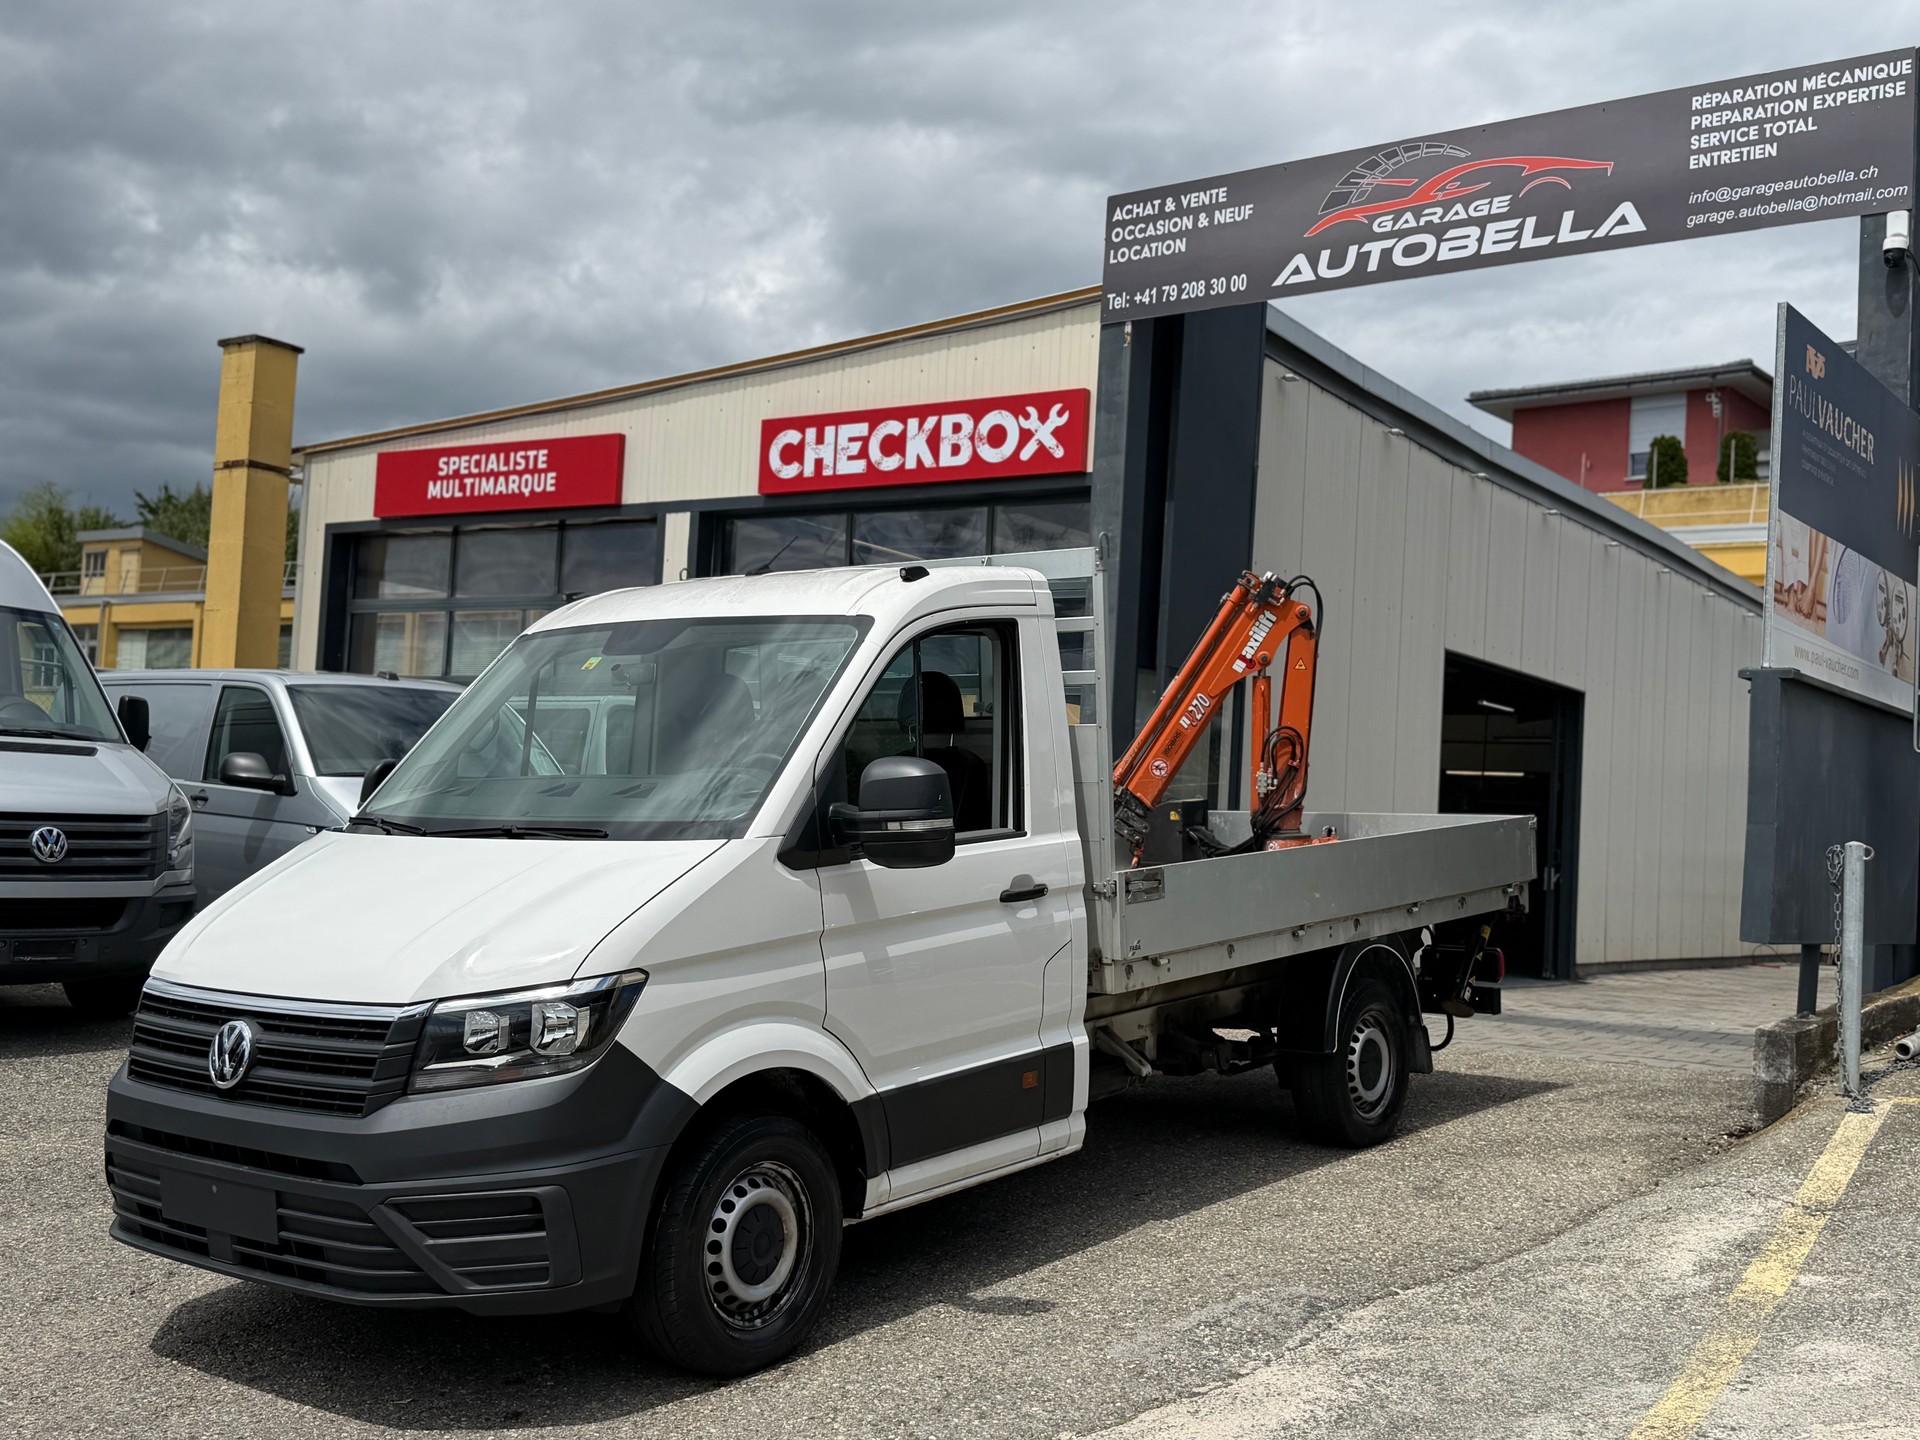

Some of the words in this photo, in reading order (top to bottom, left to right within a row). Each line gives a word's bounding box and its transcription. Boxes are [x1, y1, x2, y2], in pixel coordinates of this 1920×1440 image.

[1690, 78, 1798, 111] RÉPARATION
[1801, 58, 1913, 90] MÉCANIQUE
[1690, 97, 1808, 130] PREPARATION
[1812, 80, 1907, 109] EXPERTISE
[1689, 125, 1759, 150] SERVICE
[1763, 116, 1818, 140] TOTAL
[1689, 142, 1778, 170] ENTRETIEN
[1688, 165, 1879, 204] info@garageautobella.ch
[1111, 215, 1194, 243] OCCASION
[1197, 212, 1209, 228] &
[1213, 204, 1254, 225] NEUF
[1112, 198, 1162, 222] ACHAT
[1164, 197, 1176, 213] &
[1180, 187, 1228, 210] VENTE
[1371, 193, 1514, 233] GARAGE
[1686, 183, 1909, 228] garage.autobella@hotmail.com
[1109, 237, 1187, 265] LOCATION
[1271, 200, 1648, 288] AUTOBELLA
[1107, 291, 1131, 311] Tel:
[1133, 286, 1157, 307] +41
[1161, 285, 1178, 303] 79
[1181, 279, 1206, 301] 208
[1209, 276, 1227, 296] 30
[1229, 273, 1248, 292] 00
[768, 402, 1070, 480] CHECKBOX
[437, 448, 549, 477] SPECIALISTE
[426, 471, 557, 500] MULTIMARQUE
